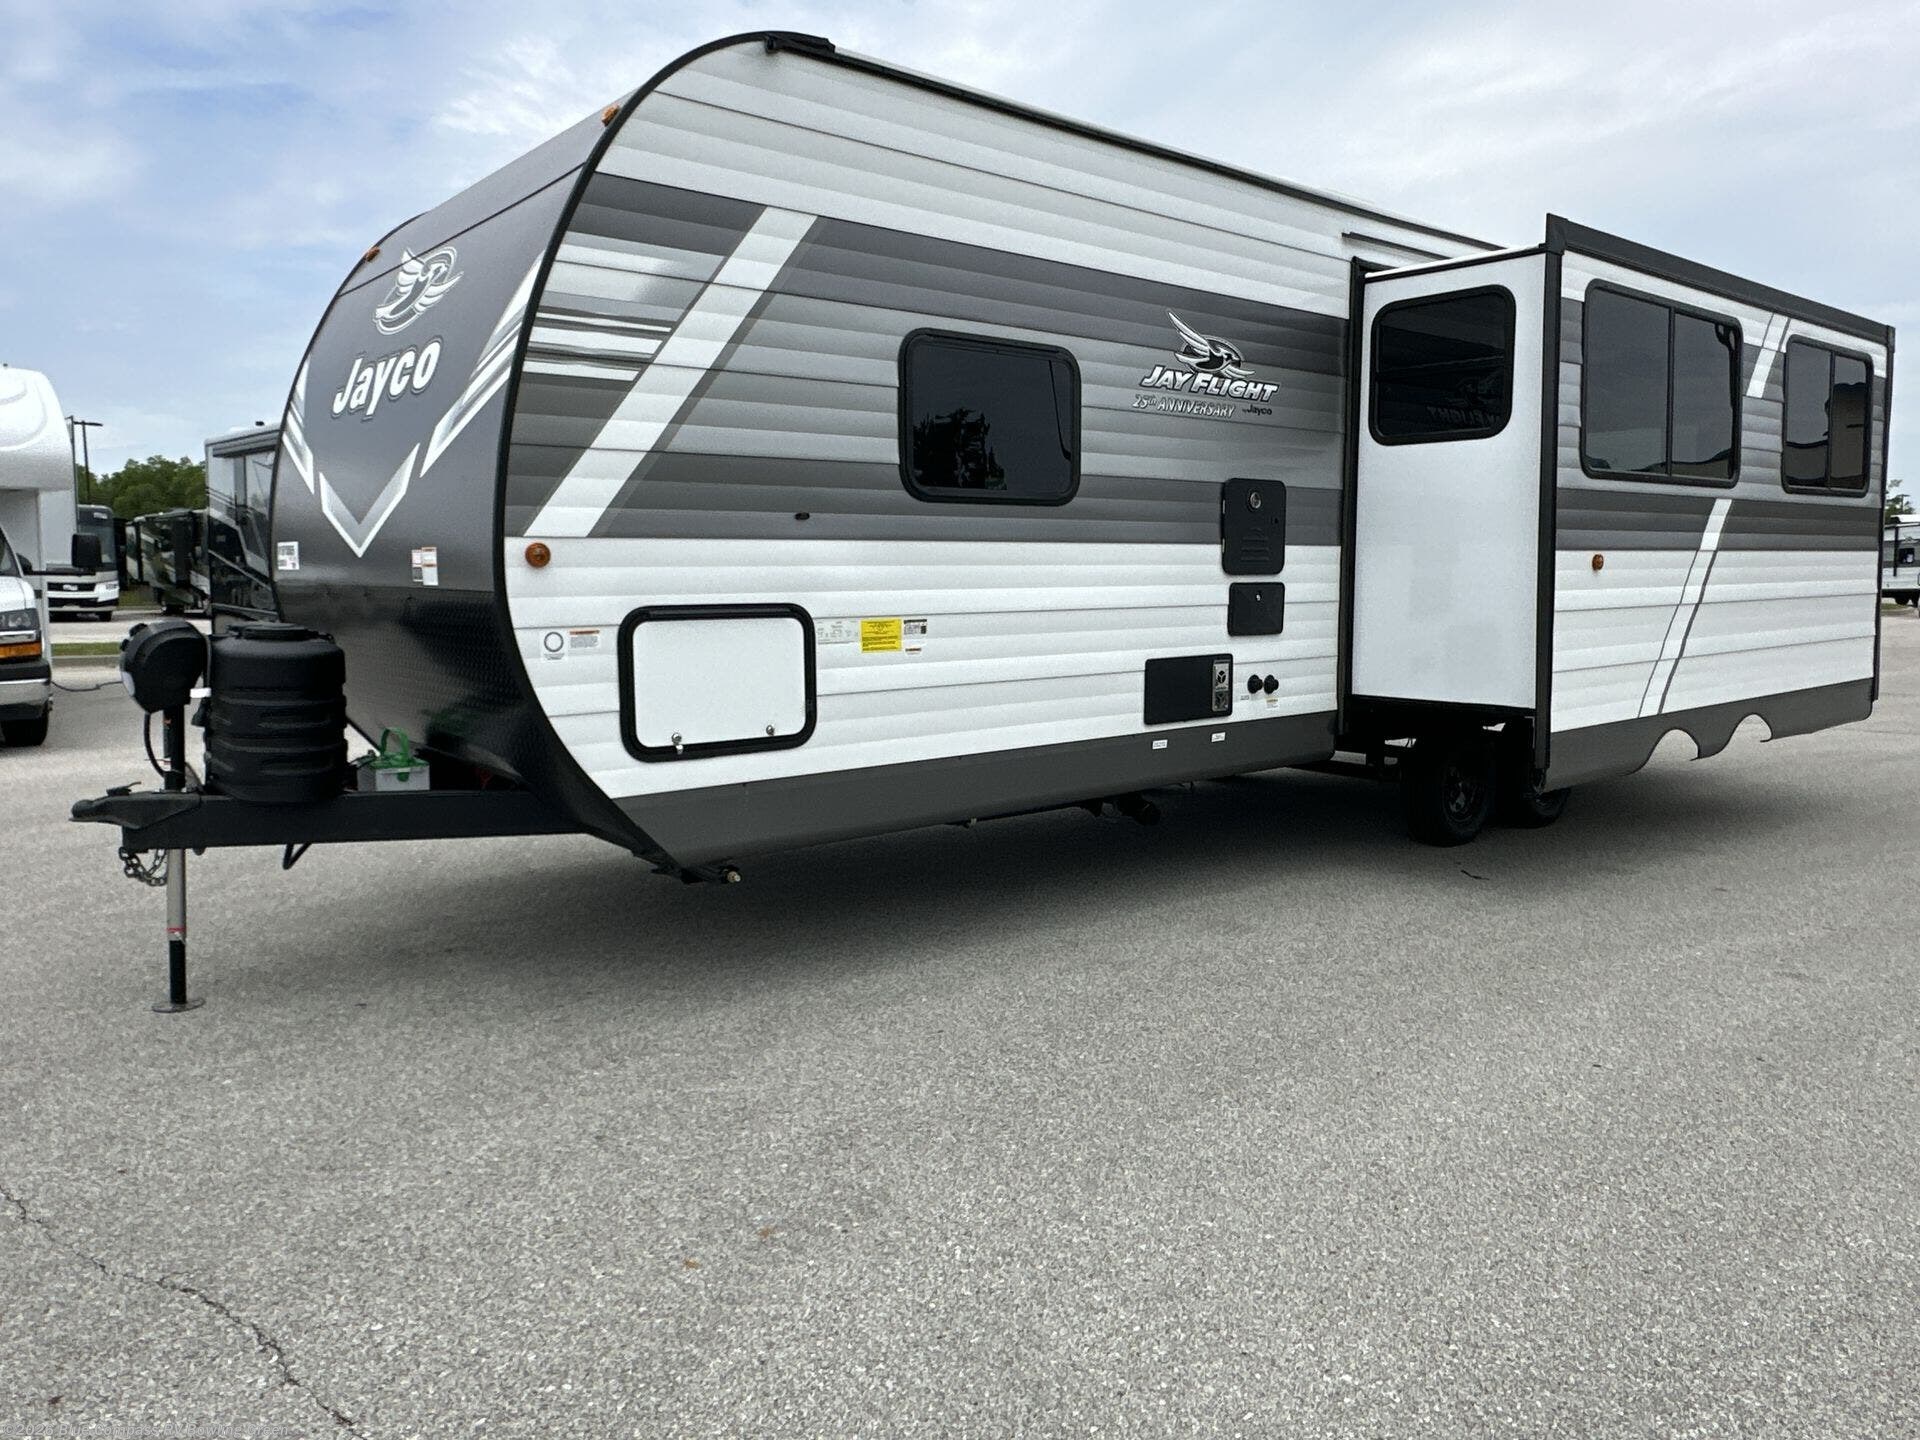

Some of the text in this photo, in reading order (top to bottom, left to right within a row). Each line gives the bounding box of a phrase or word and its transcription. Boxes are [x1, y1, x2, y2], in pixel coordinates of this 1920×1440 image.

[332, 339, 442, 417] Jayco
[1140, 365, 1280, 402] JAY FLIGHT
[1156, 395, 1236, 419] ANNIVERSARY
